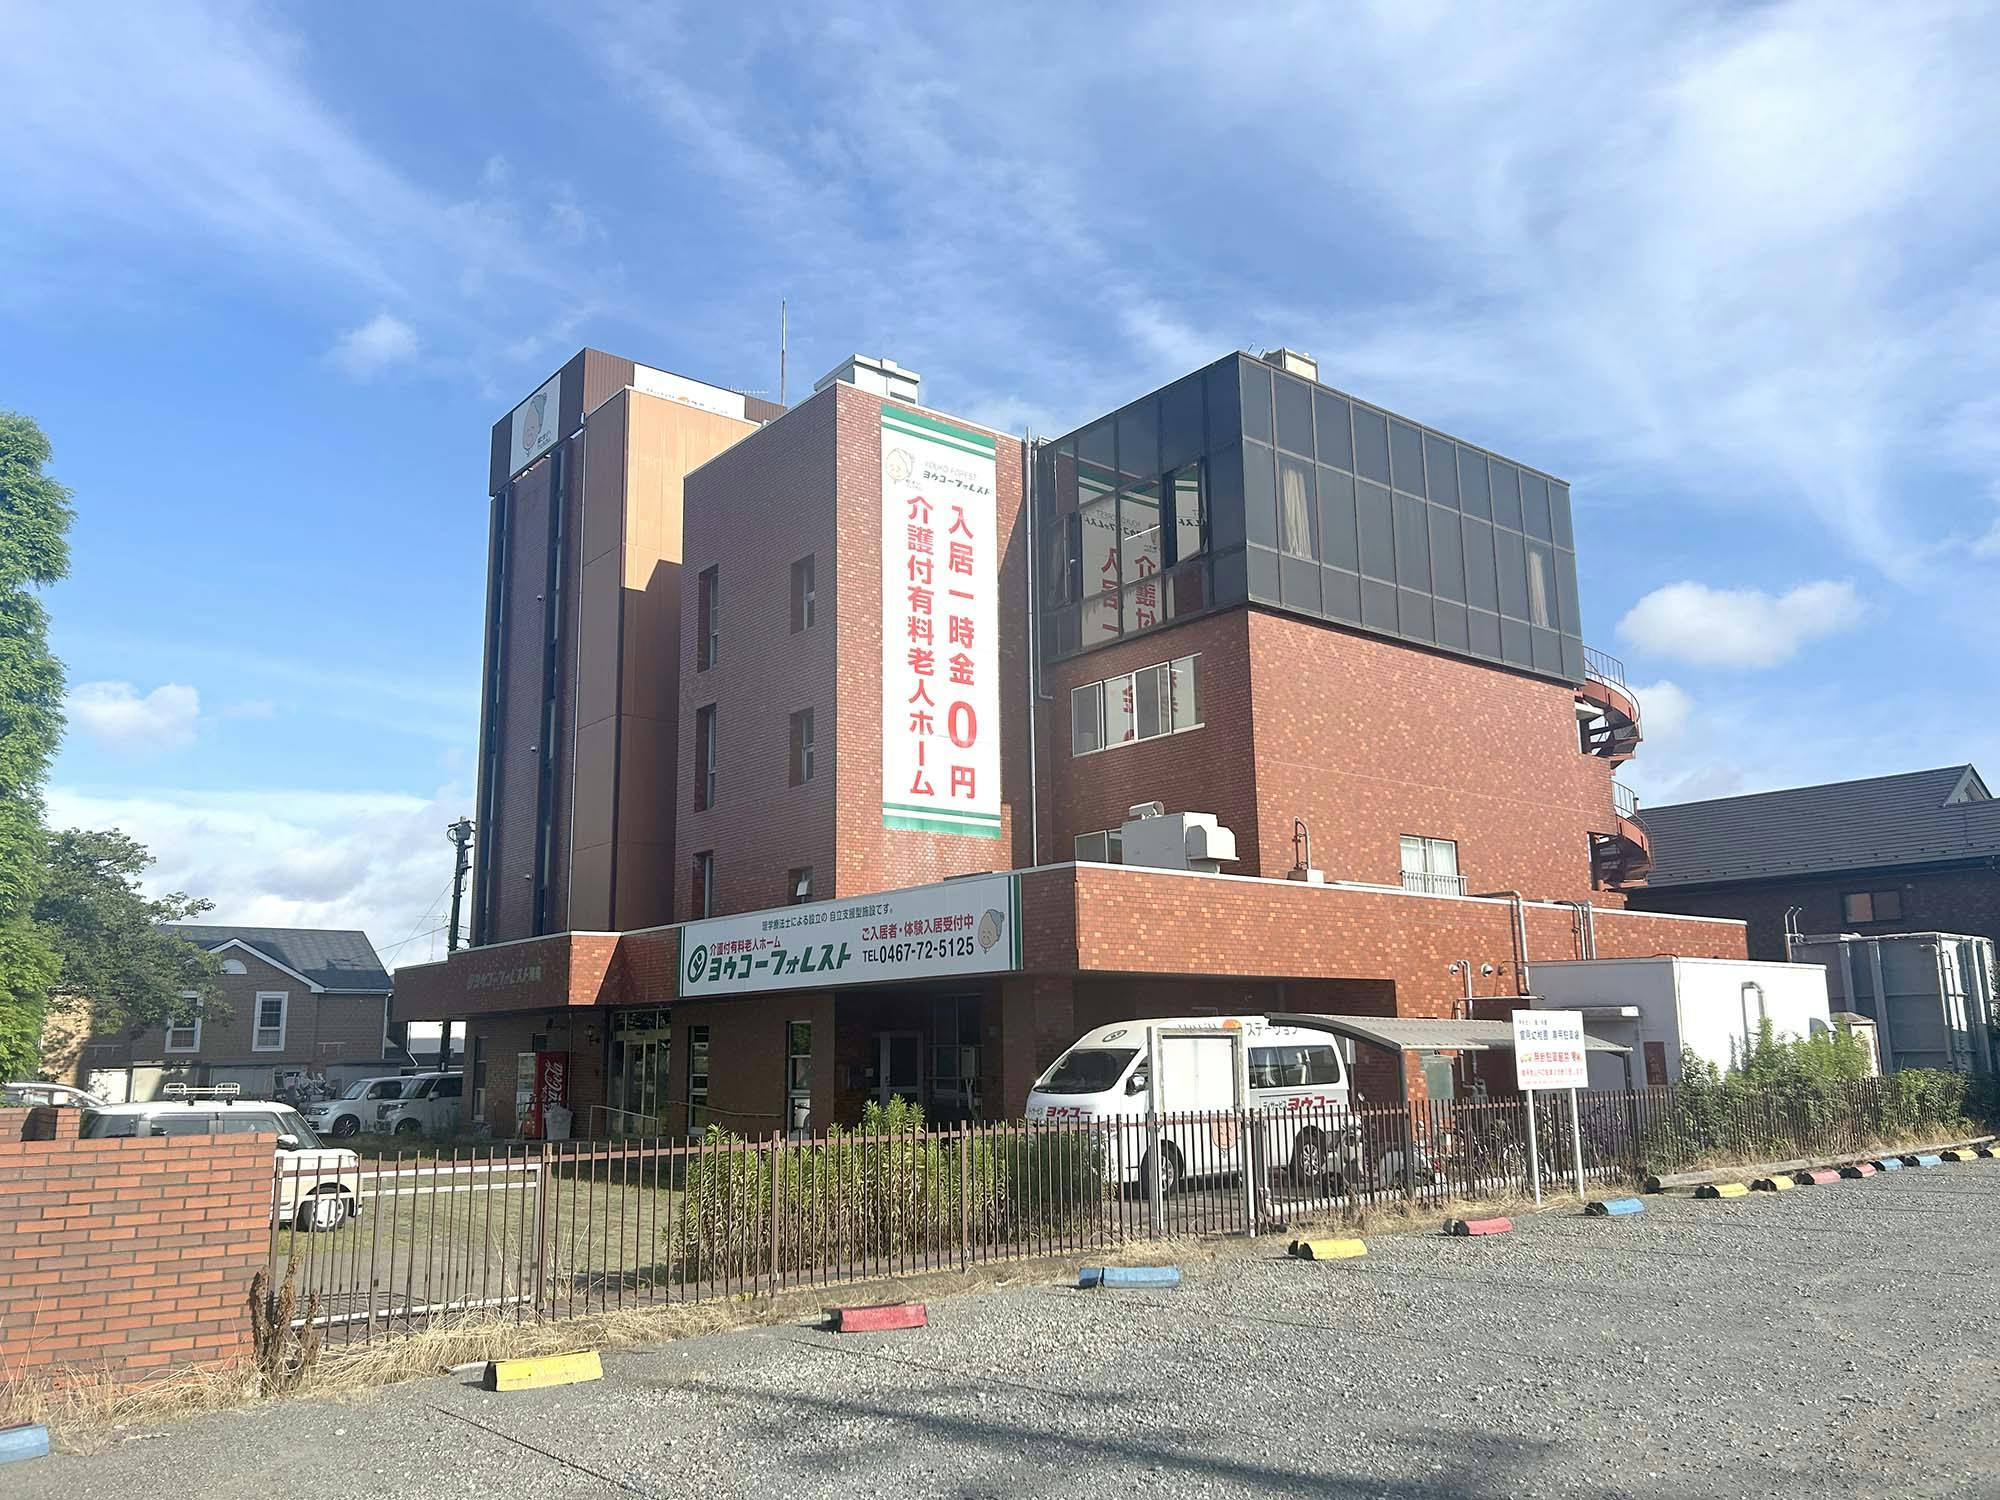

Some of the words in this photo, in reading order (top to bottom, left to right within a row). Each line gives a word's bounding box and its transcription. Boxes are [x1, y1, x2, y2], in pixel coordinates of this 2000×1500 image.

[923, 470, 990, 496] ヨウコーフォレスト
[907, 496, 935, 796] 介護付有料老人ホーム
[862, 913, 974, 942] ご入居者・体験入居受付中
[709, 936, 781, 956] 介護付有料老人ホーム
[708, 942, 851, 982] ヨウコーフォレスト
[1046, 1106, 1093, 1118] ヨウコー
[1287, 1096, 1338, 1111] ヨウコー
